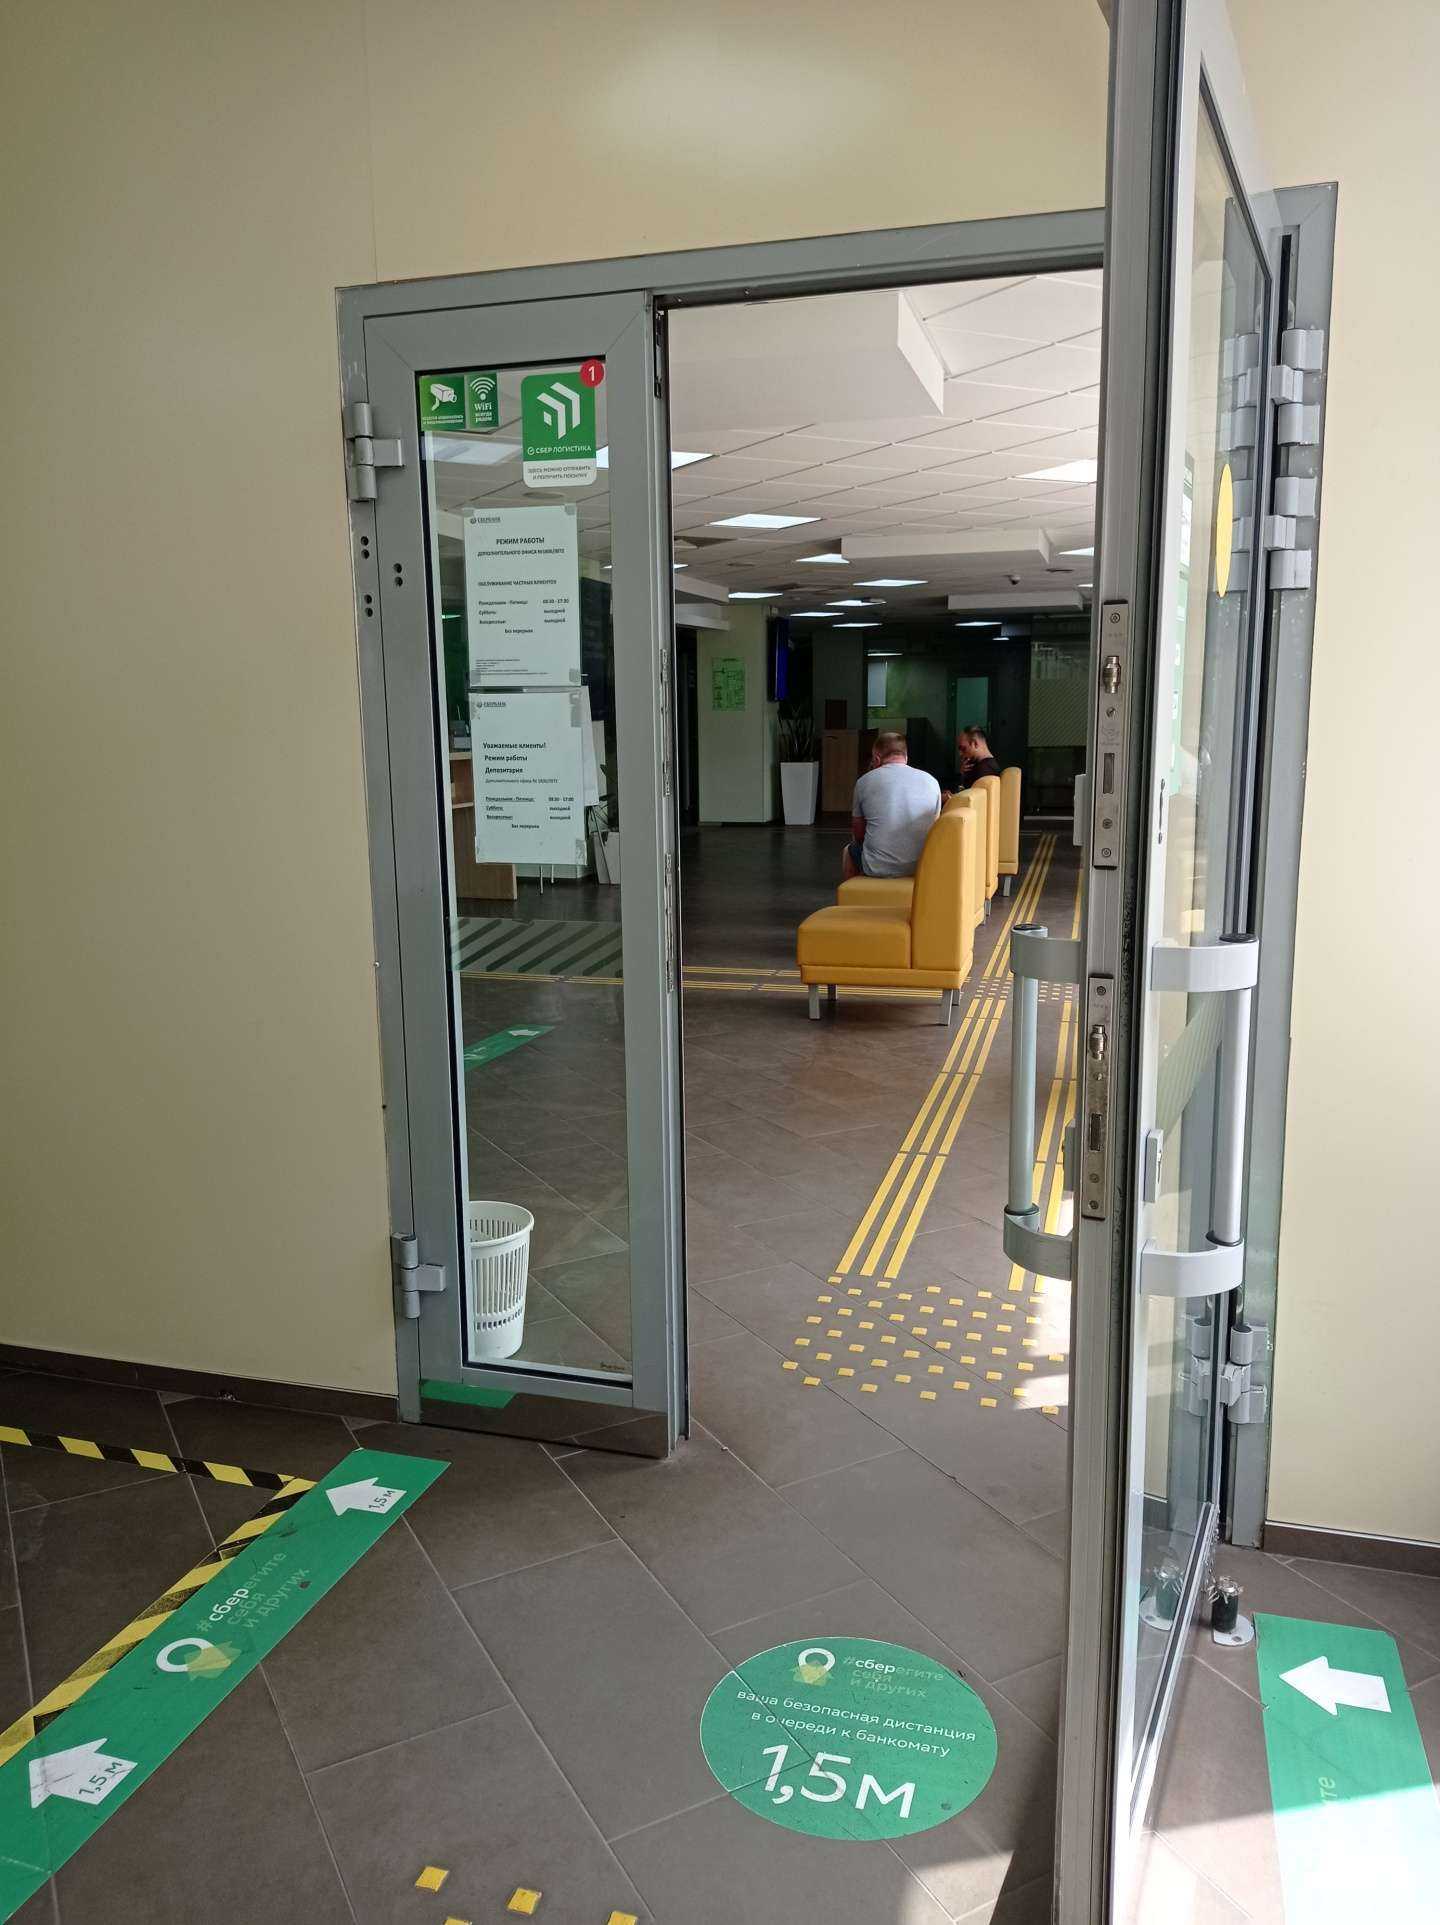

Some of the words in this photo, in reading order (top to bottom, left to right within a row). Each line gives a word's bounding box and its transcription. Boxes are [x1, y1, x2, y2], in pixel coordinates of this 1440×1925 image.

[588, 365, 597, 382] 1
[474, 402, 492, 411] WiFi
[737, 1689, 778, 1706] ваша
[783, 1694, 880, 1724] безопасная
[882, 1717, 977, 1742] дистанция
[751, 1712, 760, 1720] в
[841, 1729, 851, 1739] к
[856, 1730, 951, 1757] банкомату
[760, 1743, 853, 1804] 1,5
